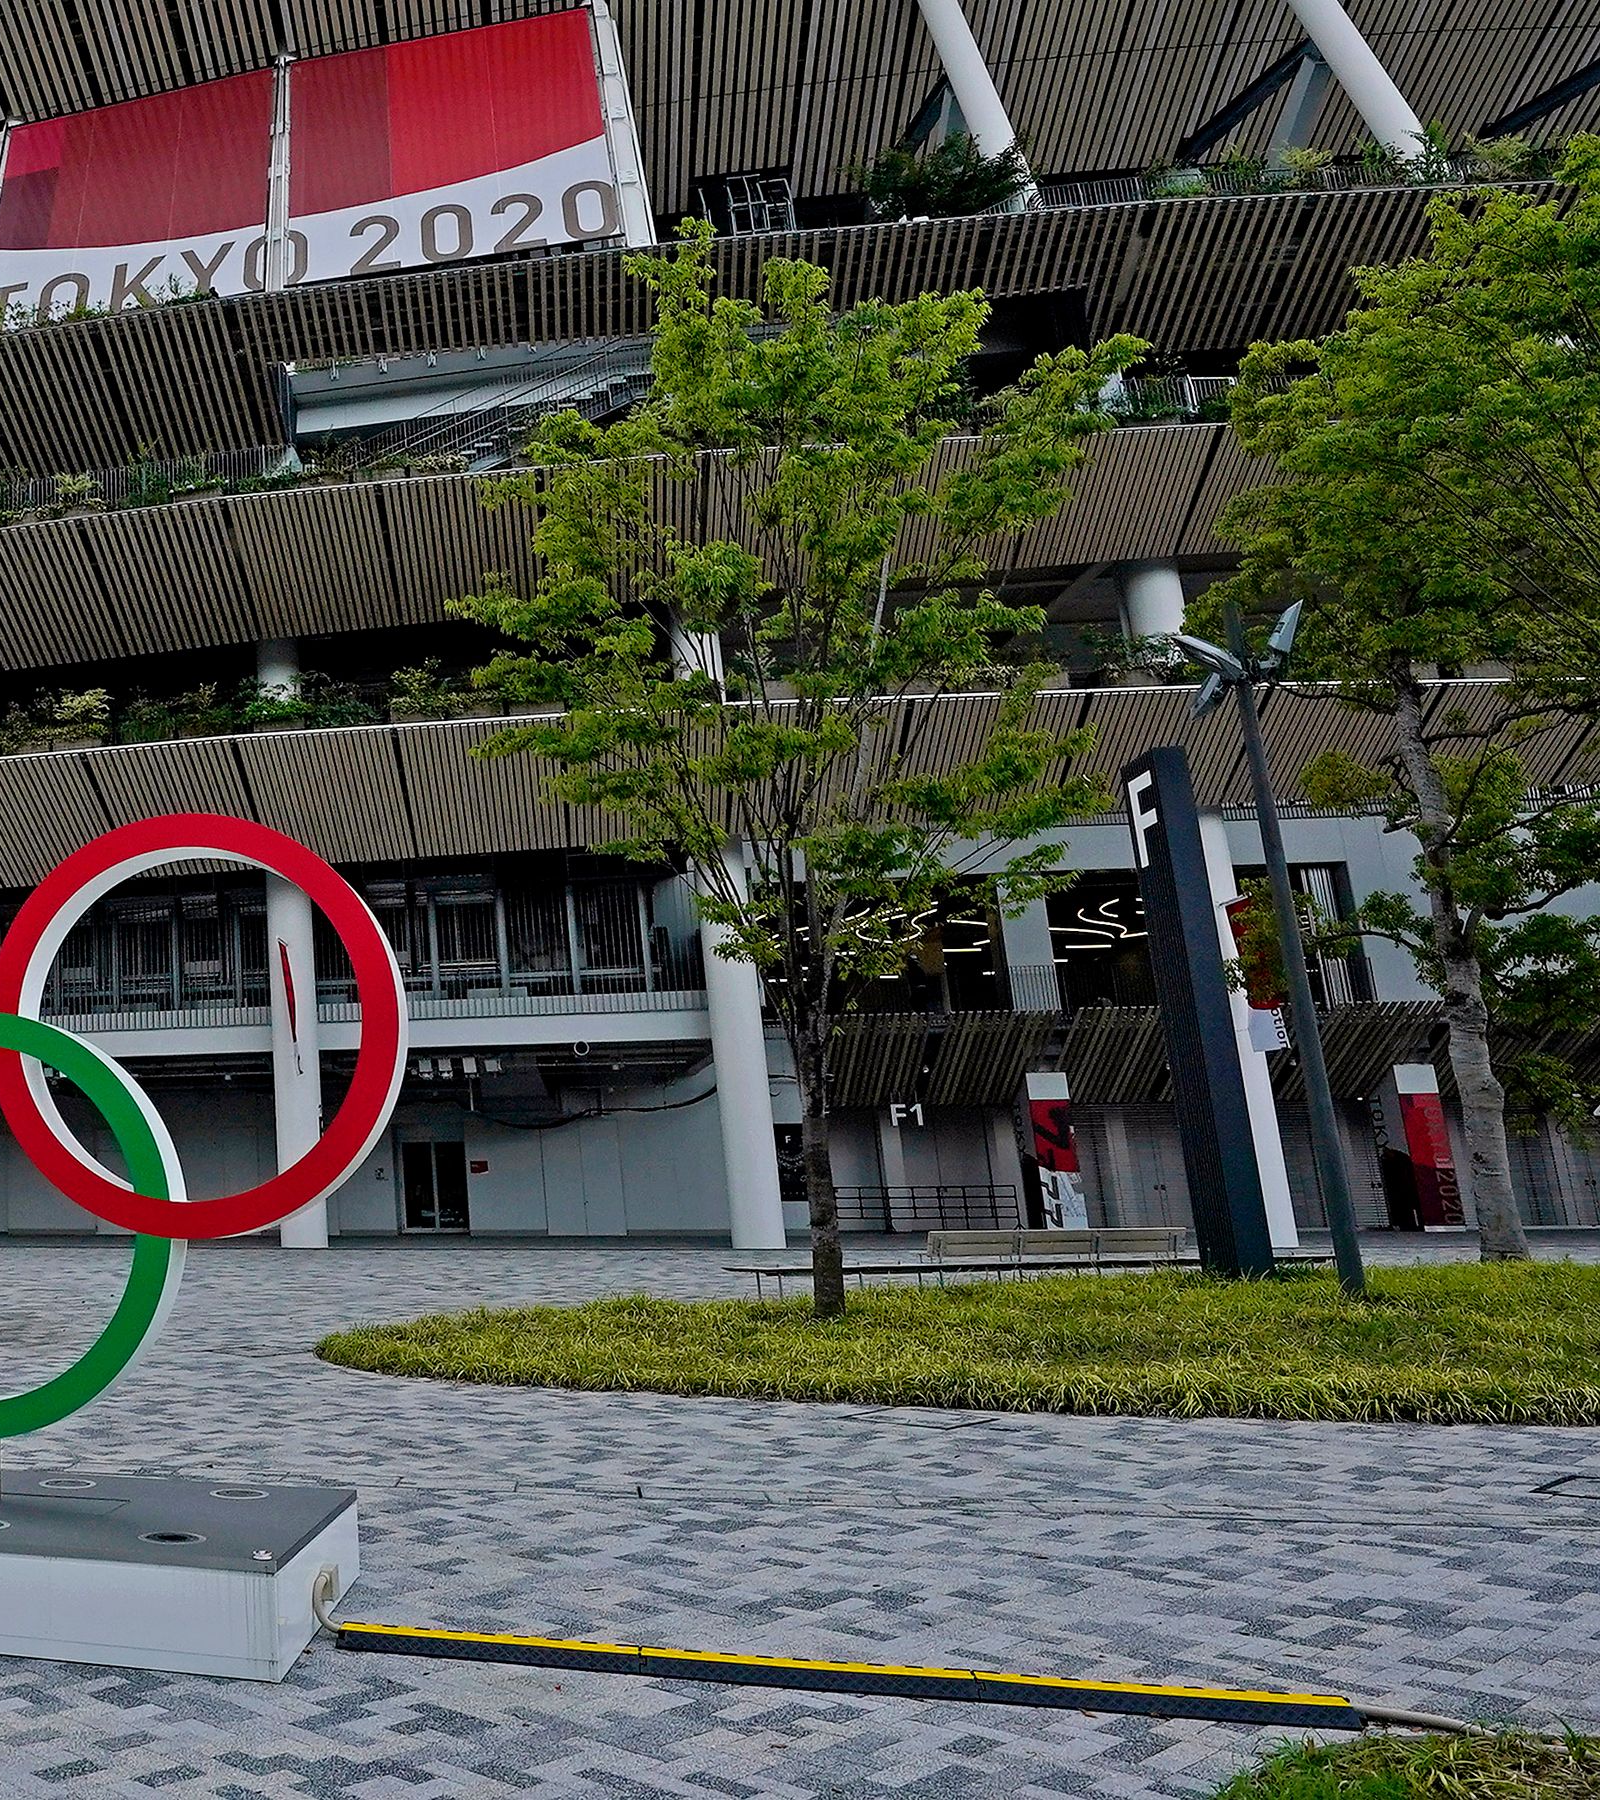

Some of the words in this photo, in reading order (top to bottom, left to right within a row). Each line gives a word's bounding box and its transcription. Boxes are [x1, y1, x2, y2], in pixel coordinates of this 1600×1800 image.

[349, 180, 621, 276] 2020
[1128, 770, 1158, 868] F
[890, 1103, 924, 1127] F1
[1436, 1169, 1466, 1225] 2020
